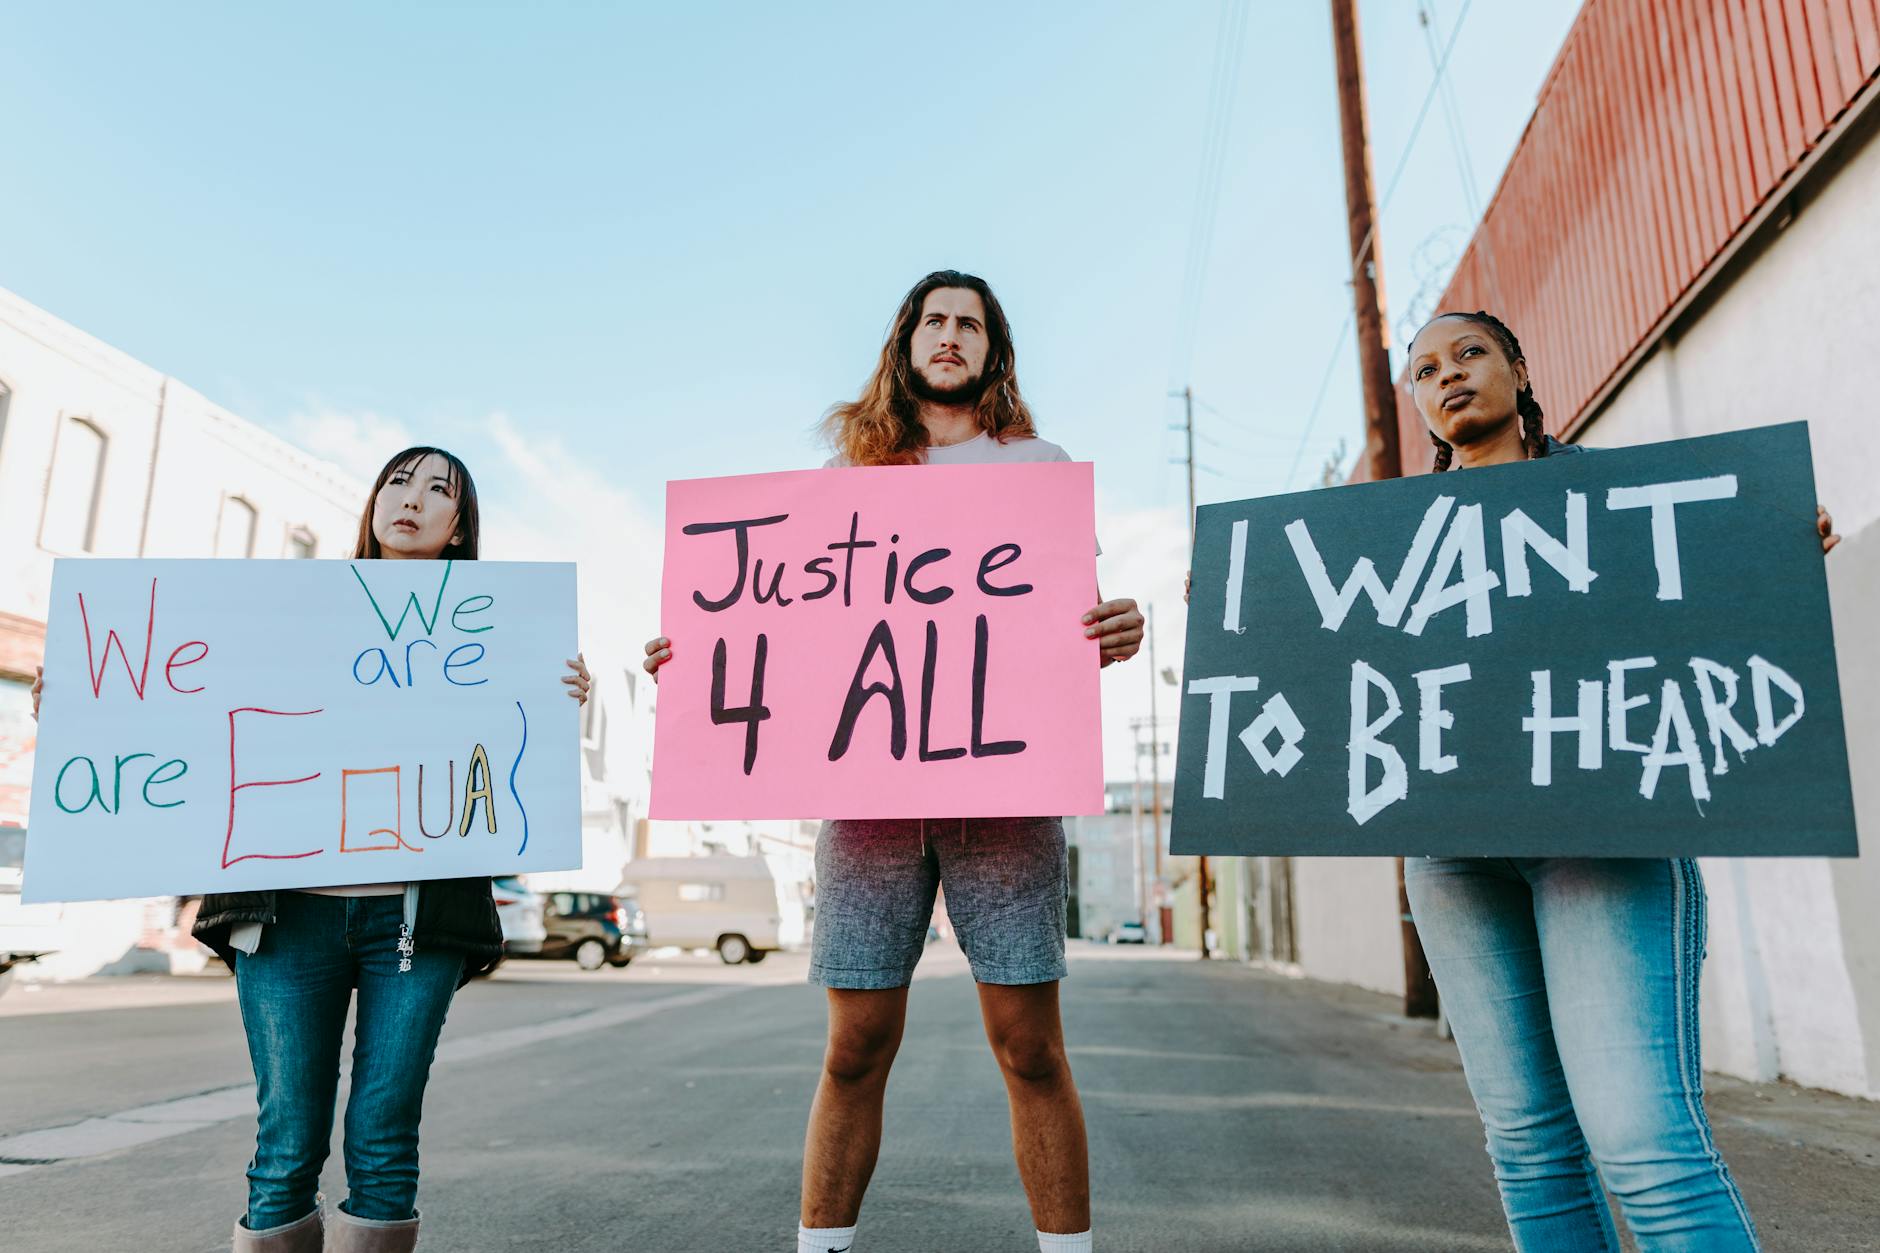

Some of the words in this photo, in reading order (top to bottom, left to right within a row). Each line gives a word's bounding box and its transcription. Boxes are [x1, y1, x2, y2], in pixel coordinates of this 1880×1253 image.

[350, 560, 496, 642] We
[682, 511, 1034, 613] Justice
[1222, 518, 1249, 636] I
[1283, 473, 1739, 639] WANT
[78, 575, 209, 701] We
[352, 640, 490, 688] are
[711, 632, 772, 776] 4
[827, 614, 1028, 763] ALL
[54, 752, 189, 816] are
[1187, 674, 1306, 801] TO
[1345, 658, 1473, 827] BE
[1521, 654, 1806, 805] HEARD
